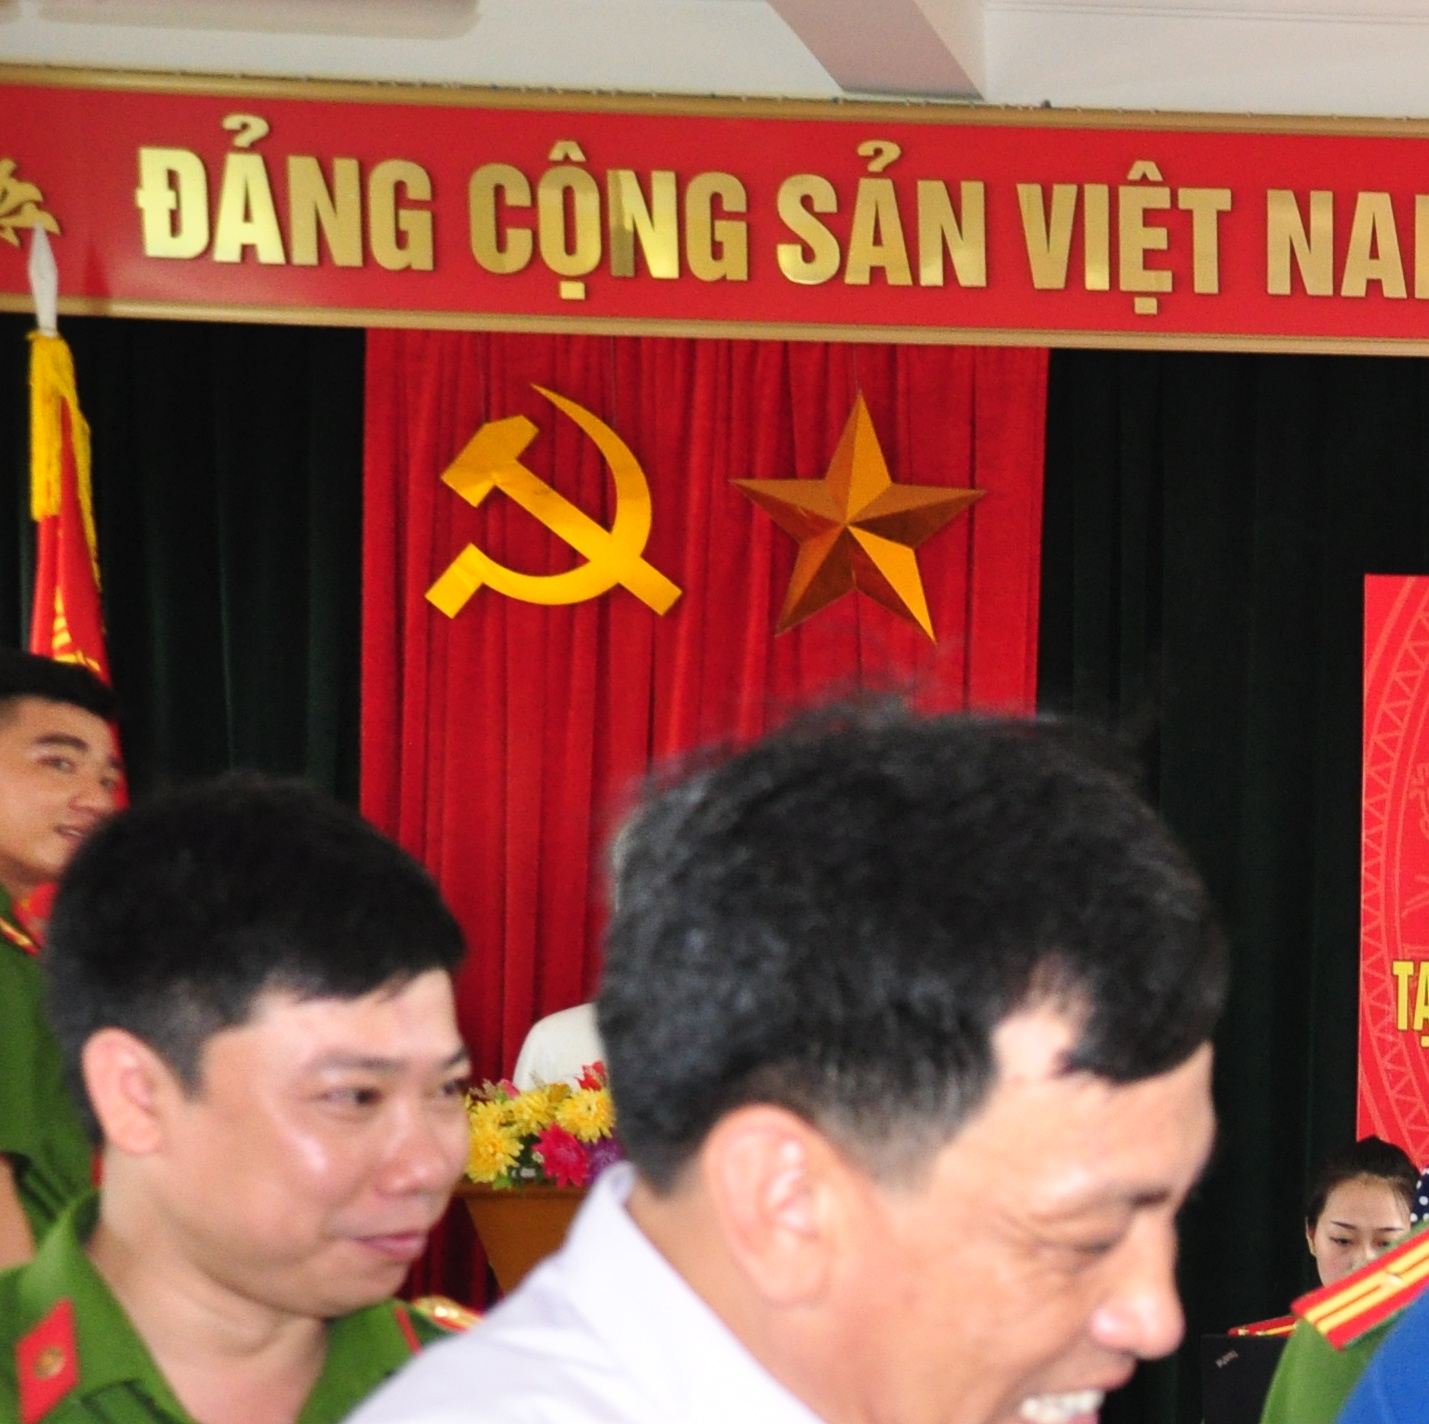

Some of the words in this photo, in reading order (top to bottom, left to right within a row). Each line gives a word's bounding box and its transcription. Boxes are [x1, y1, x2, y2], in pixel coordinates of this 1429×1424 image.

[135, 112, 434, 271] ĐẢNG
[468, 140, 748, 300] CỘNG
[777, 139, 988, 287] SẢN
[1016, 160, 1232, 315] VIỆT
